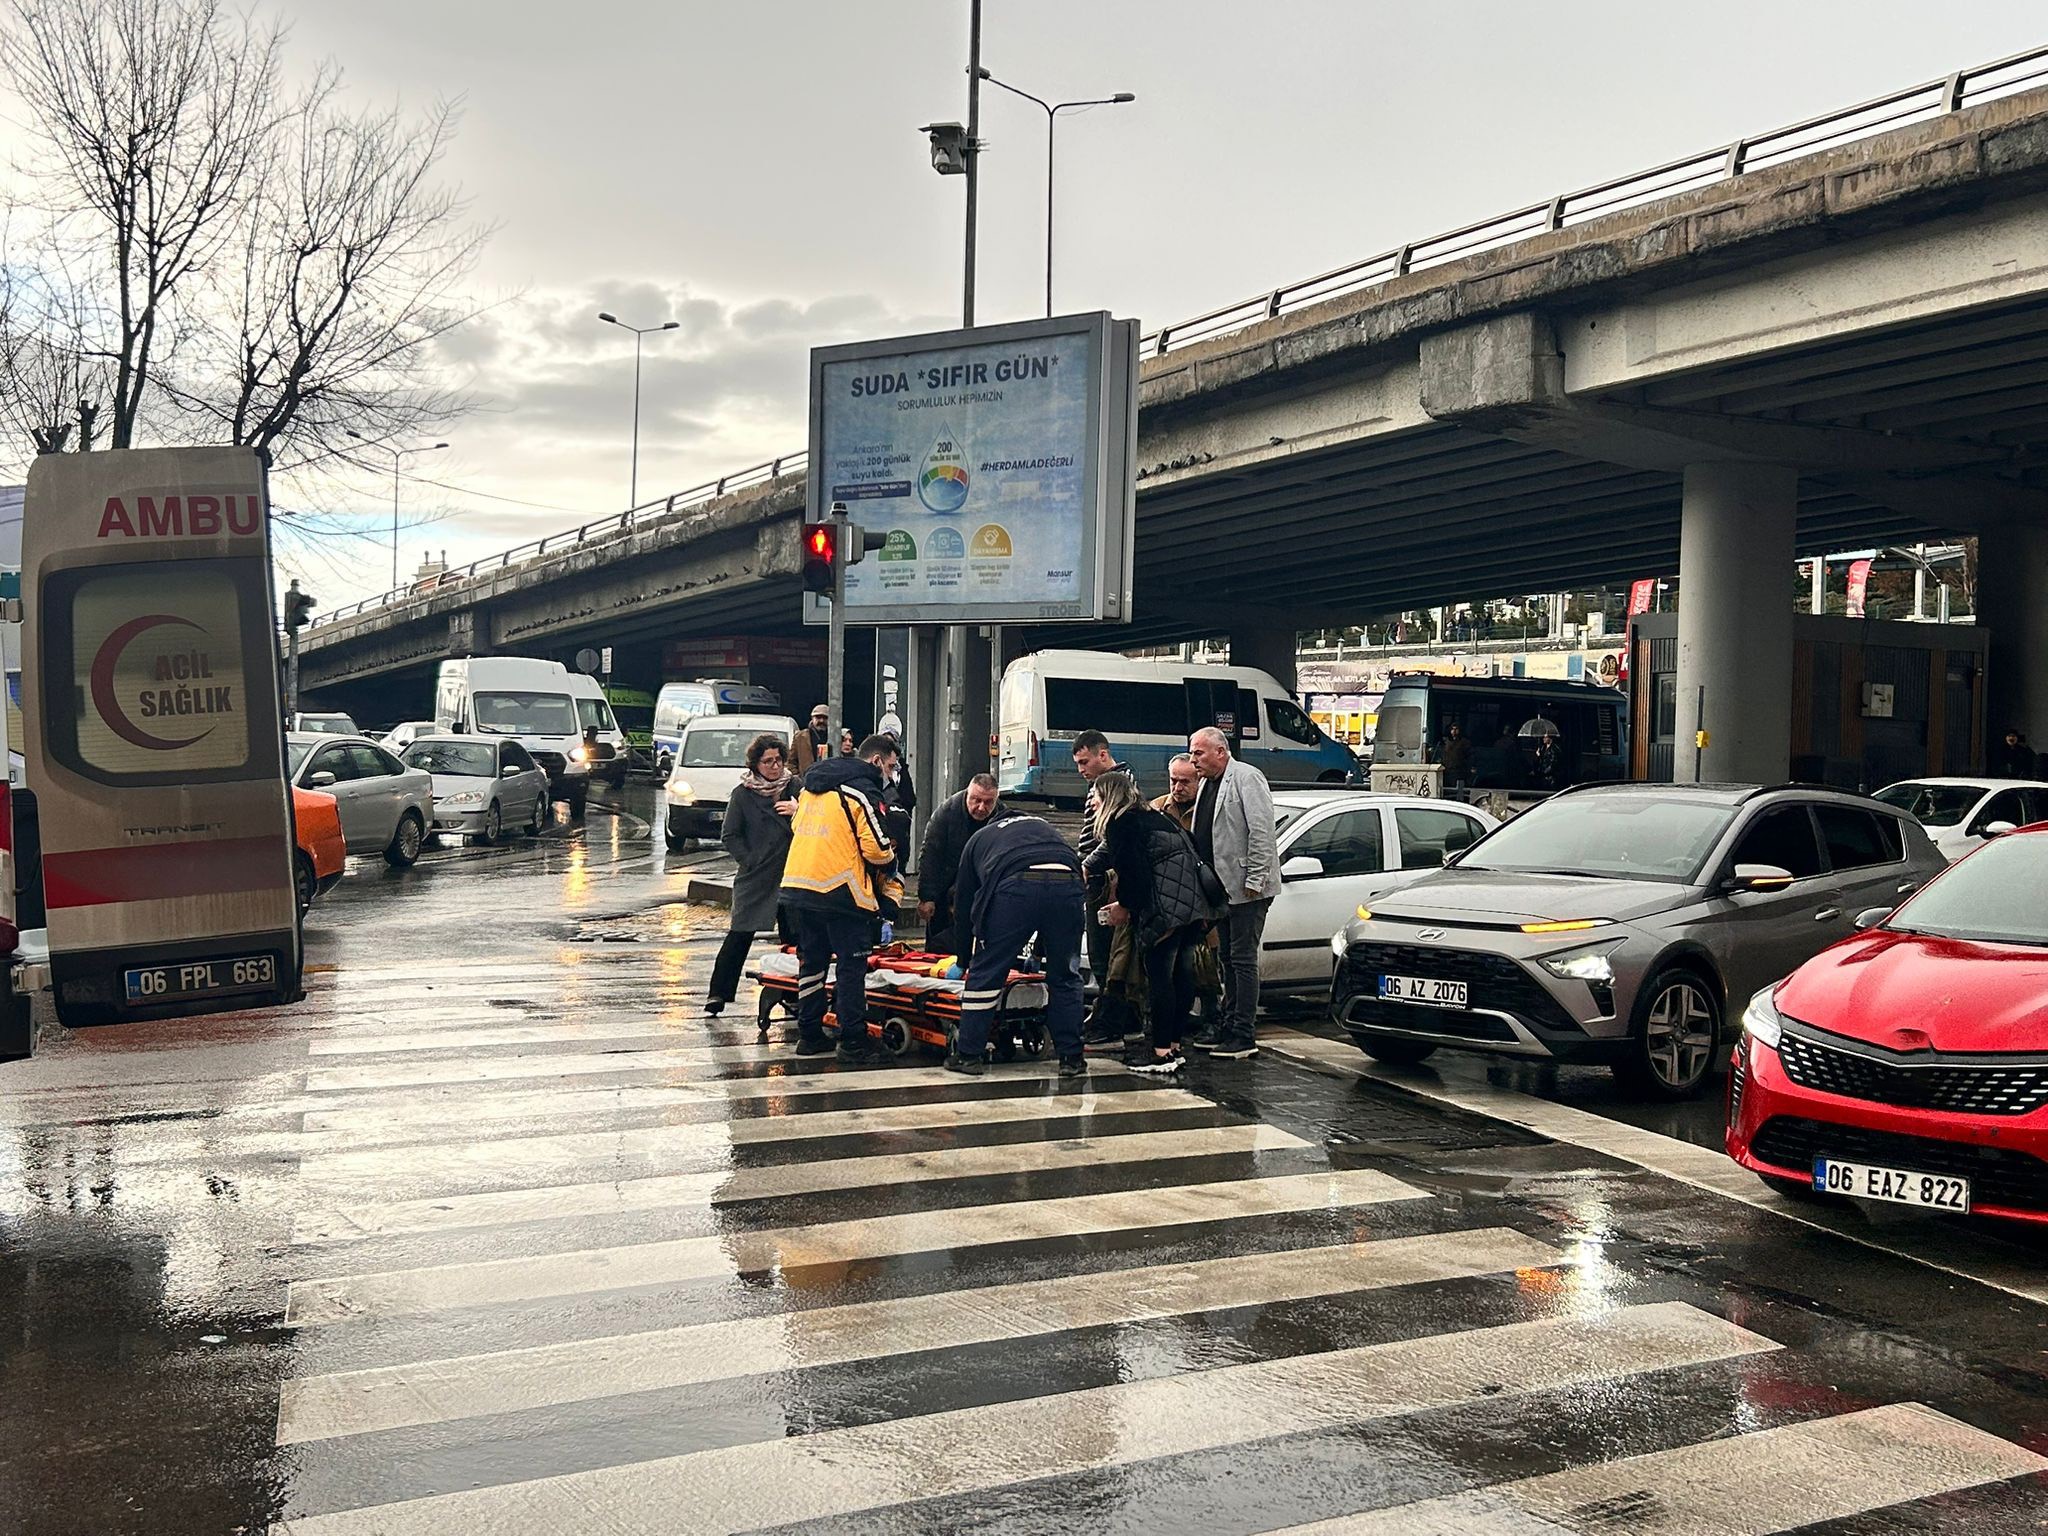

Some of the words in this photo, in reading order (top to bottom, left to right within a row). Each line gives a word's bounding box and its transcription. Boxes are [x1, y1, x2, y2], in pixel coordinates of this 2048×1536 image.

[851, 372, 910, 398] SUDA
[898, 395, 957, 411] SORUMLULUK
[959, 390, 1003, 405] HEPİMİZİN
[937, 441, 953, 453] 200
[866, 457, 882, 466] 200
[883, 454, 911, 467] günlük
[980, 454, 1074, 472] #HERDAMLADEĞERLİ
[97, 495, 259, 538] AMBU
[890, 533, 905, 543] 25%
[1039, 604, 1081, 617] STRÖER
[155, 649, 214, 681] ACİL
[139, 684, 233, 717] SAĞLIK
[123, 821, 226, 836] TRANSIT
[140, 970, 167, 995] 06
[180, 965, 219, 991] FPL
[233, 958, 272, 985] 663
[1386, 977, 1401, 995] 06
[1410, 979, 1426, 998] AZ
[1433, 981, 1466, 1002] 2076
[1828, 1164, 1854, 1191] 06
[1867, 1169, 1908, 1200] EAZ
[1920, 1176, 1963, 1208] 822
